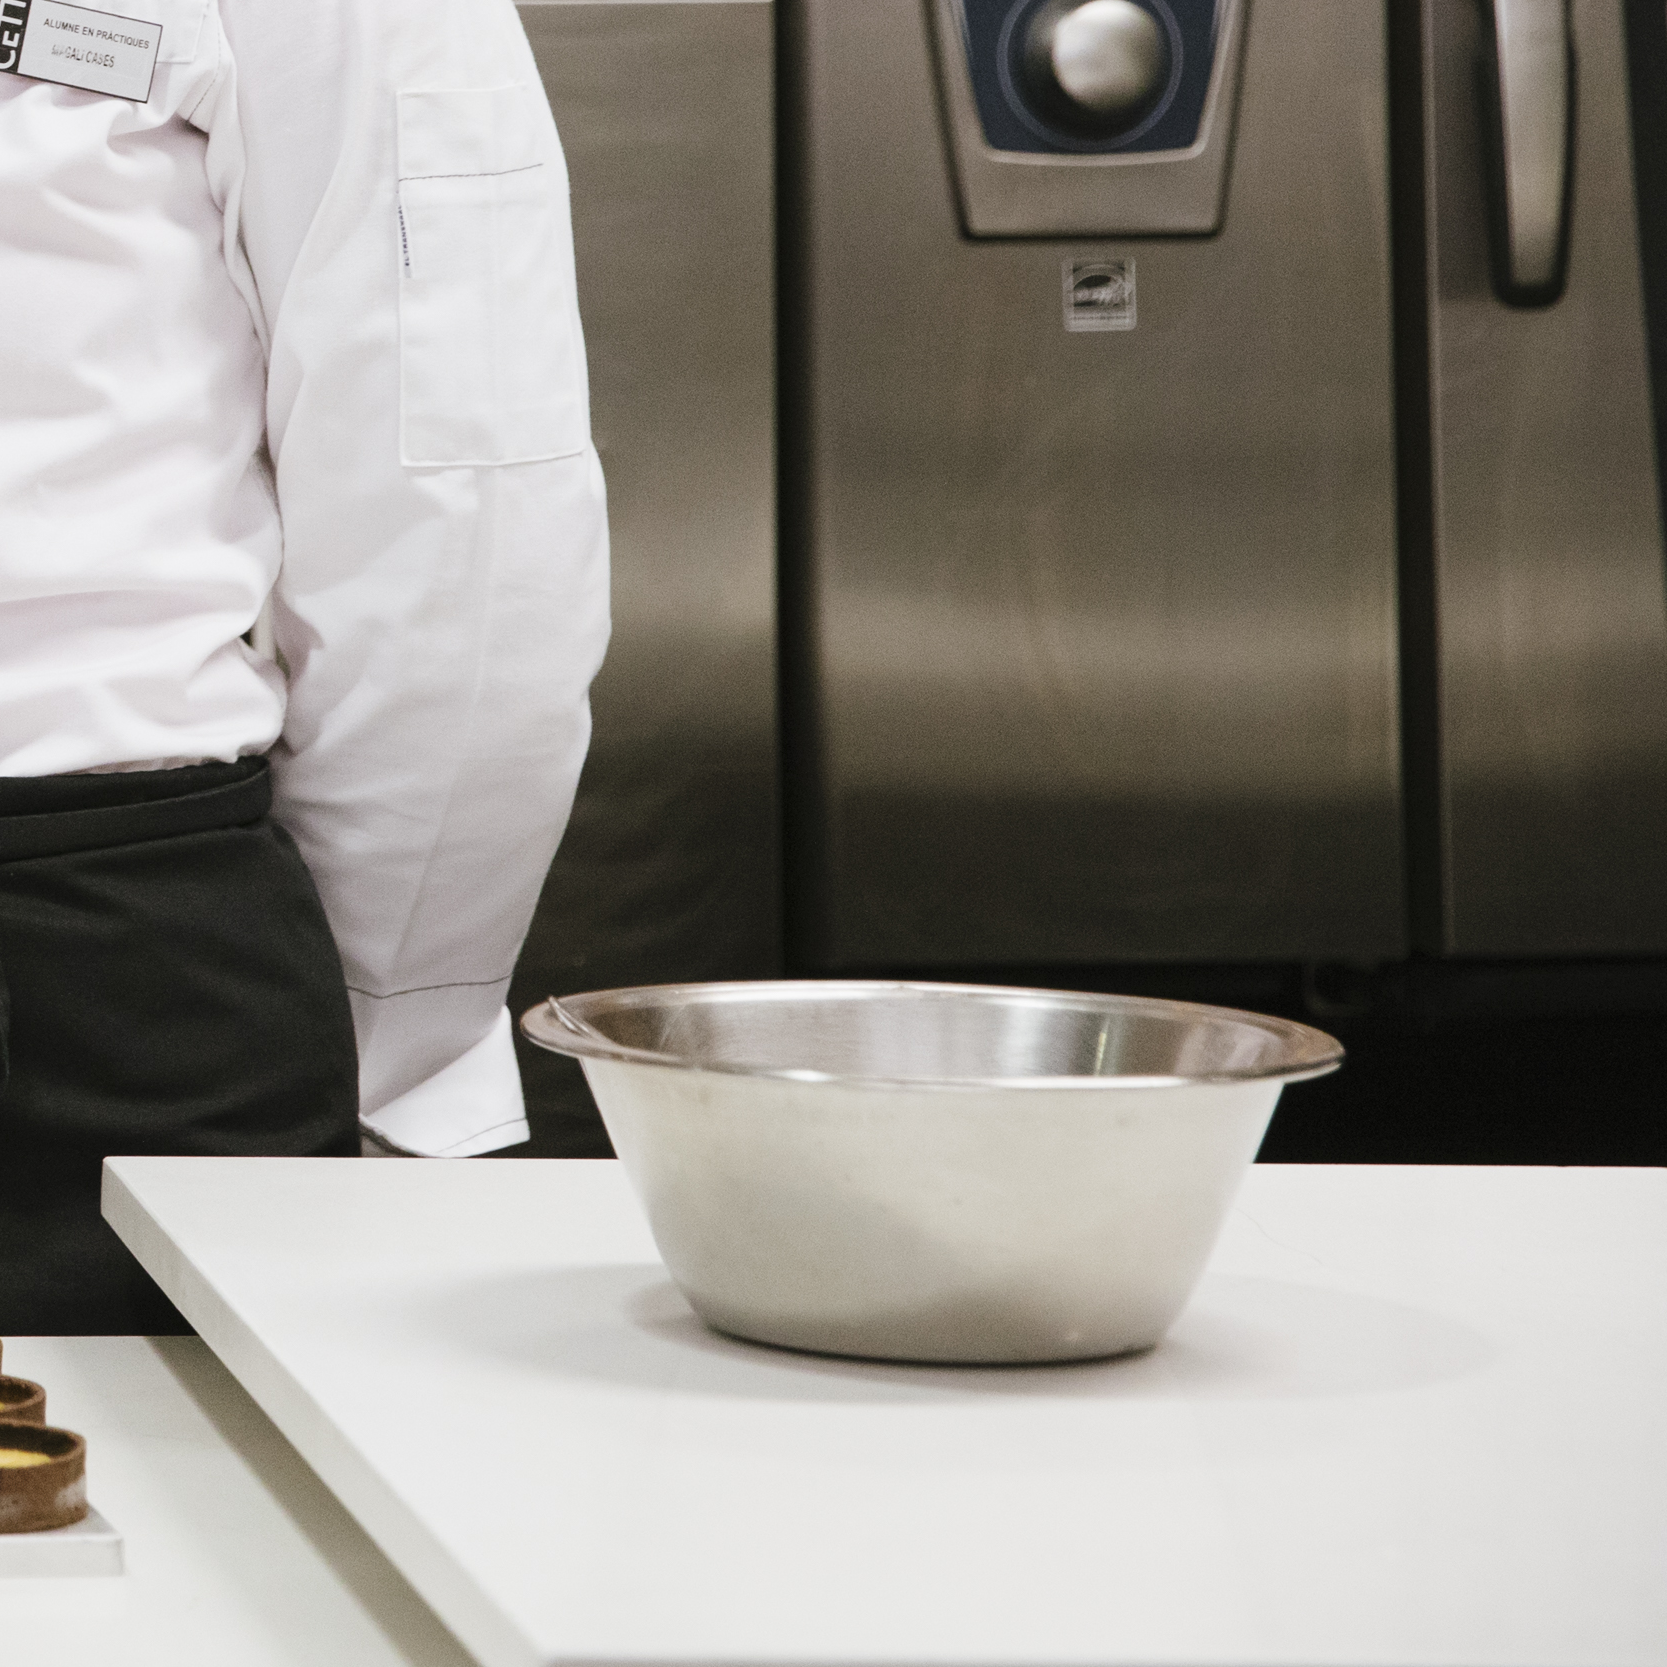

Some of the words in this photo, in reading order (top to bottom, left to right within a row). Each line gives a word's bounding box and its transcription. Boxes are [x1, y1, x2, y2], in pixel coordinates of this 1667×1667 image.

[43, 18, 80, 34] ALUMNE
[81, 26, 95, 38] EN
[96, 29, 150, 50] PRÀCTIQUES
